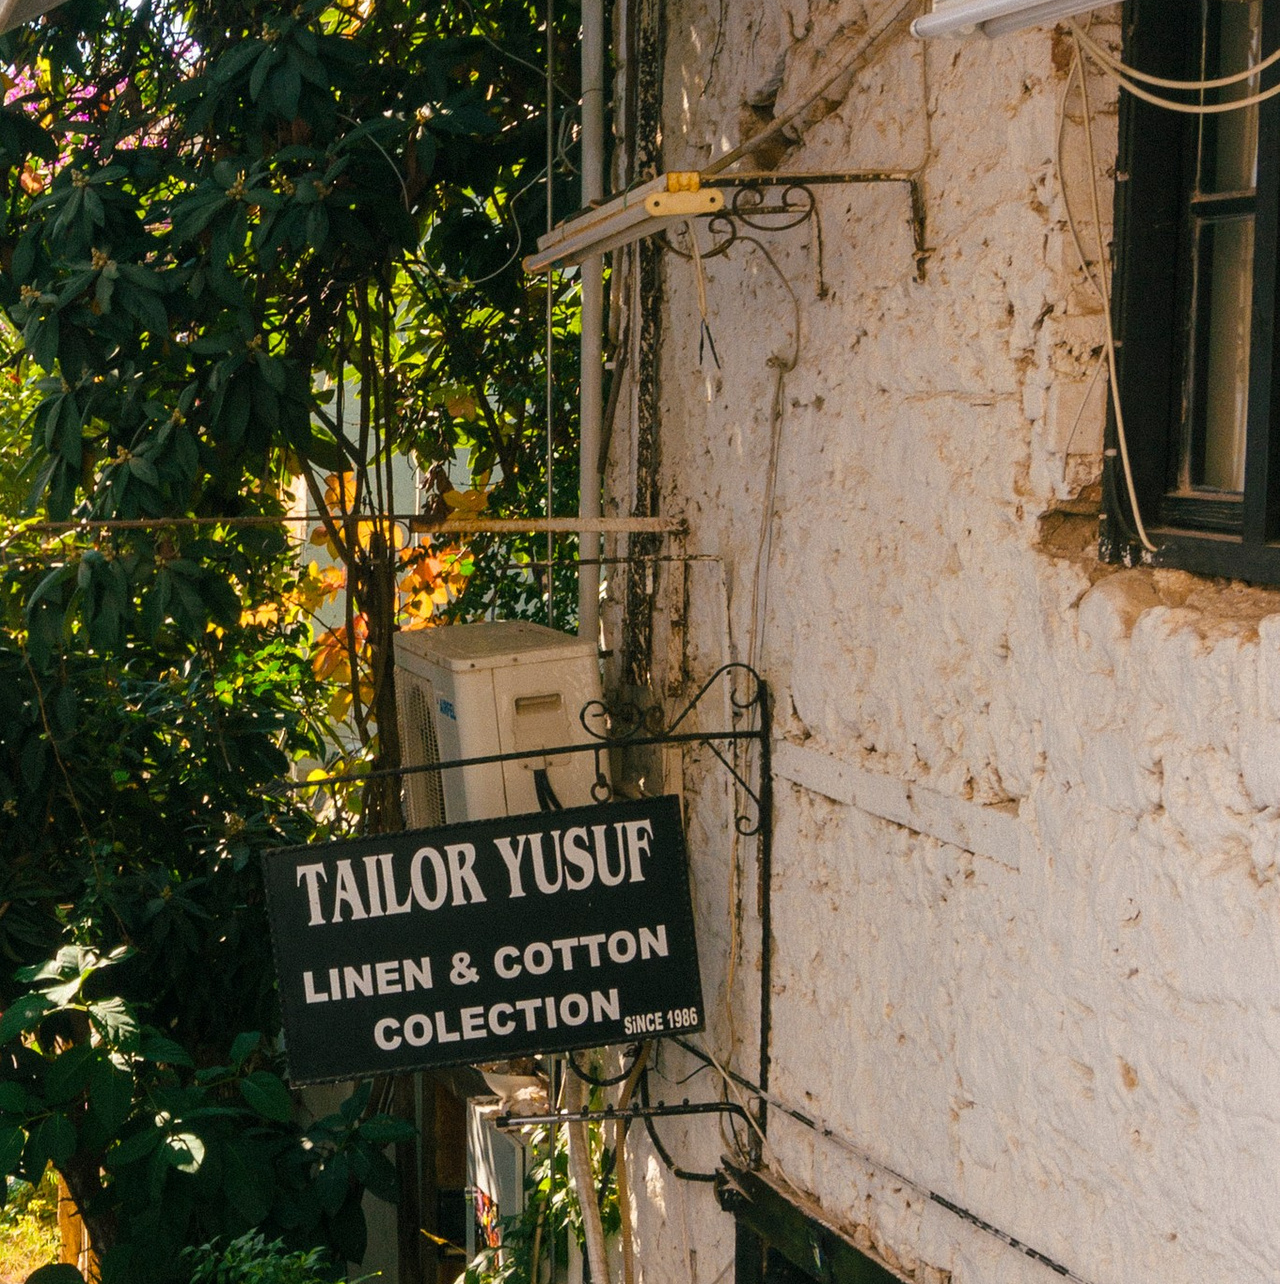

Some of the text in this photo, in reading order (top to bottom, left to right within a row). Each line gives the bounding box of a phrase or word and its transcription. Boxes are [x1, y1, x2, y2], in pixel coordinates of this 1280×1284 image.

[296, 819, 654, 927] TAILOR YUSUF
[303, 924, 669, 1004] LINEN & COTTON
[373, 988, 620, 1051] COLECTION
[667, 1007, 698, 1029] 1986
